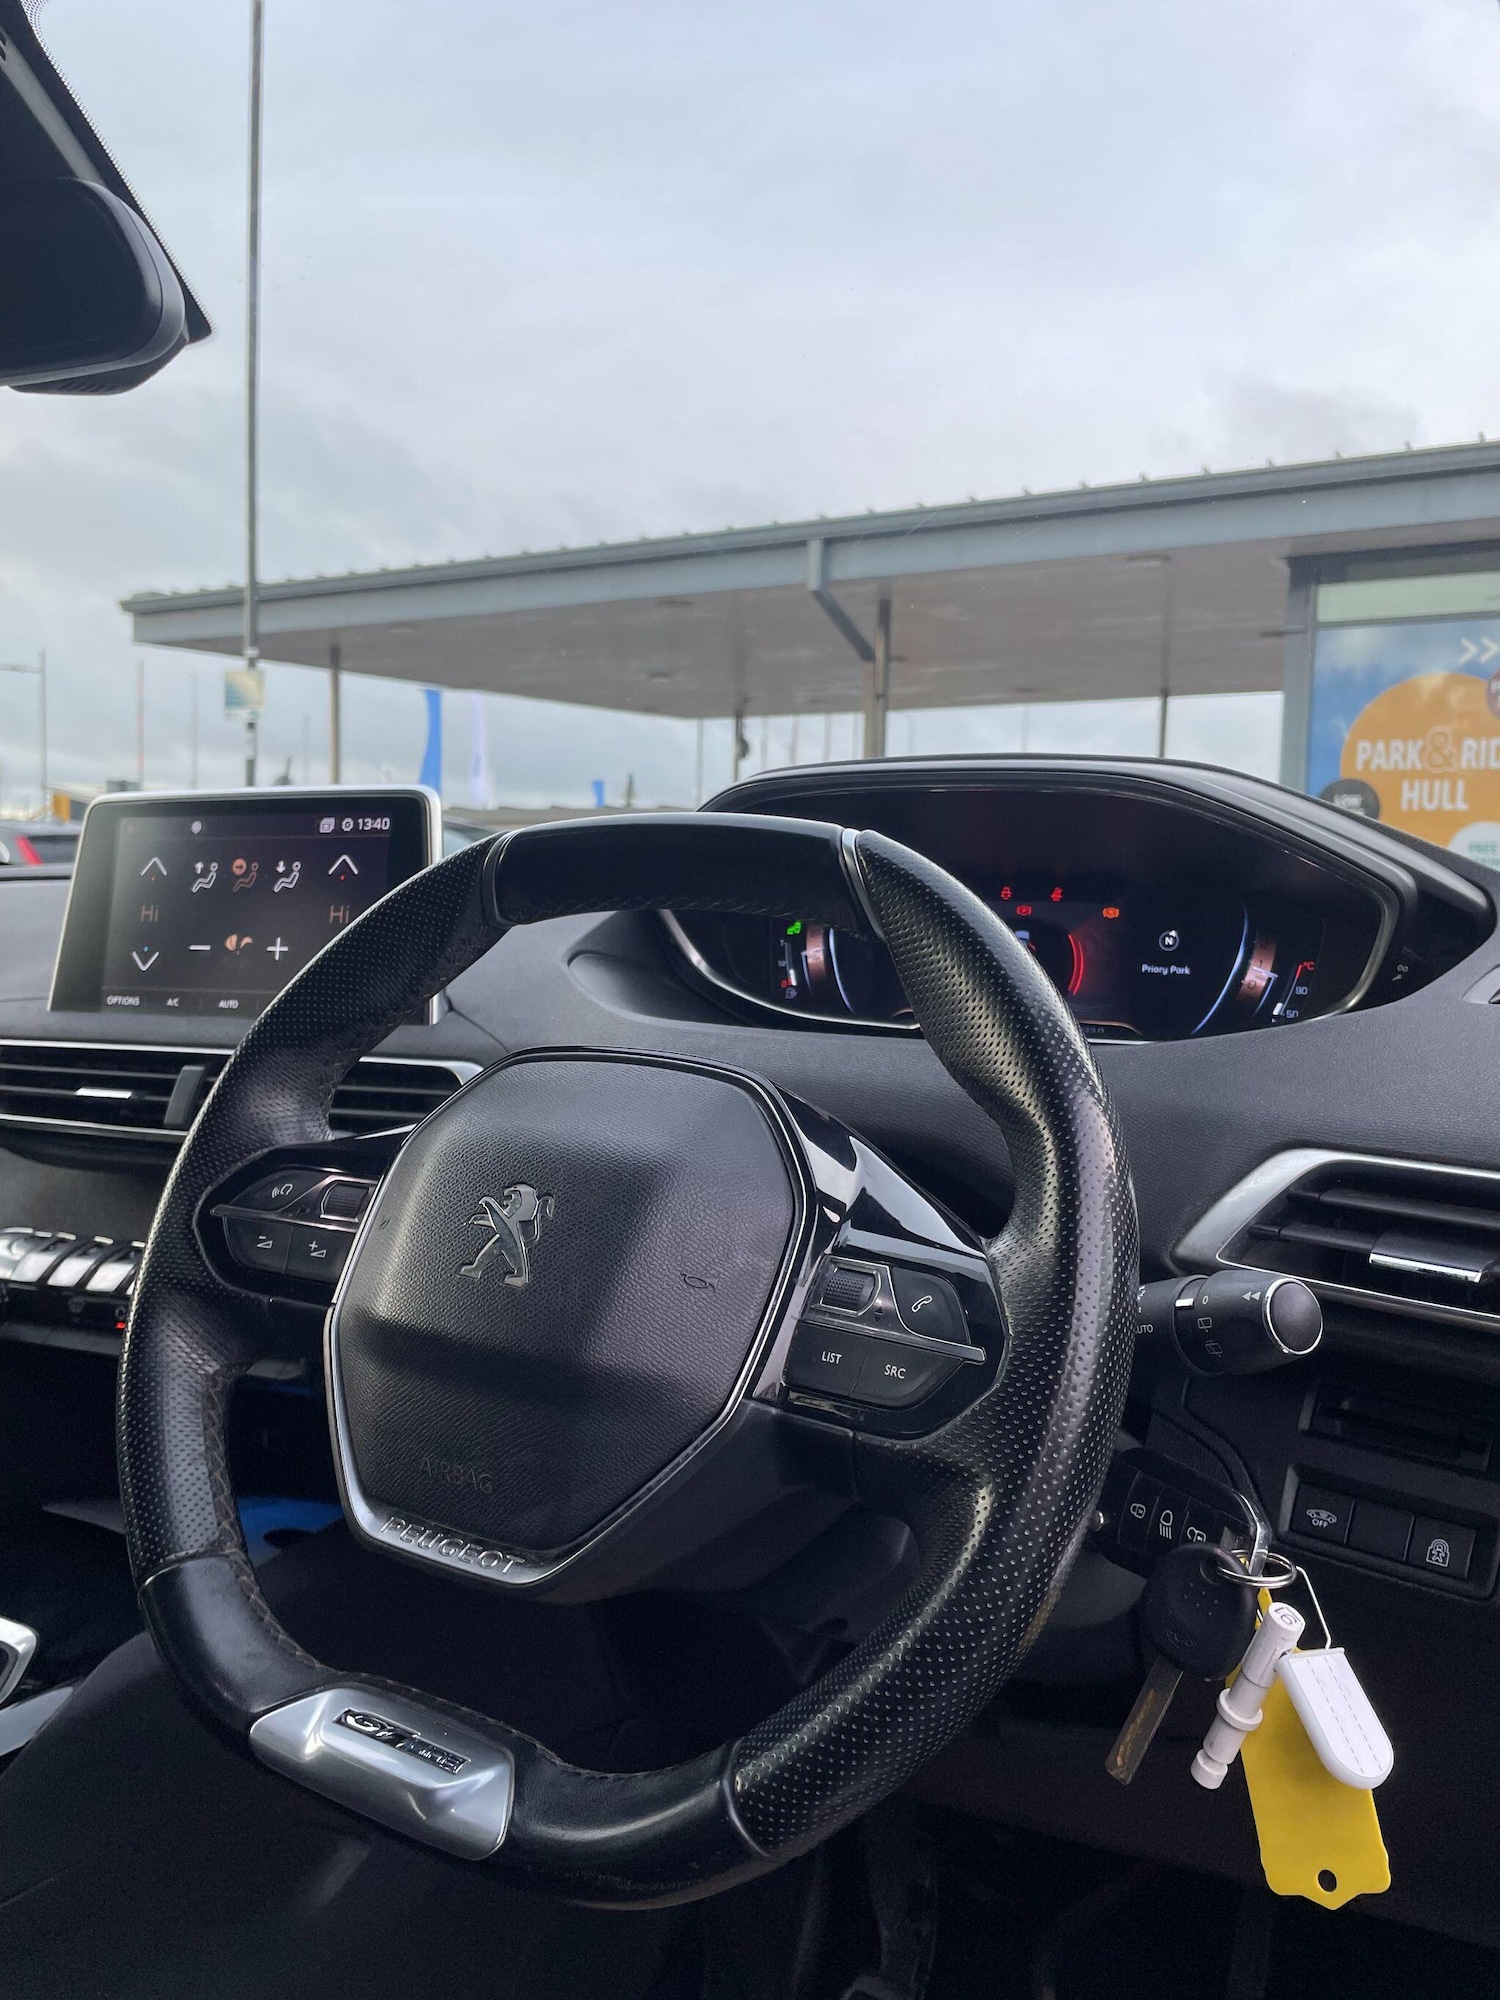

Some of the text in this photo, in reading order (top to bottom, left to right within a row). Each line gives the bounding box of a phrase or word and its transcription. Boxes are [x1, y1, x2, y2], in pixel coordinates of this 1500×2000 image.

[1356, 739, 1423, 770] PARK
[1423, 725, 1458, 773] &
[1401, 778, 1469, 811] HULL
[141, 904, 159, 922] Hi
[329, 905, 350, 924] Hi
[1141, 964, 1190, 976] Priory Park
[107, 995, 140, 1006] OPTIONS
[218, 999, 238, 1009] AUTO
[821, 1351, 843, 1365] LIST
[884, 1364, 906, 1380] SRC
[421, 1456, 494, 1494] AIRBAG
[1311, 1518, 1329, 1528] OFF
[380, 1516, 526, 1574] PEUGEOT
